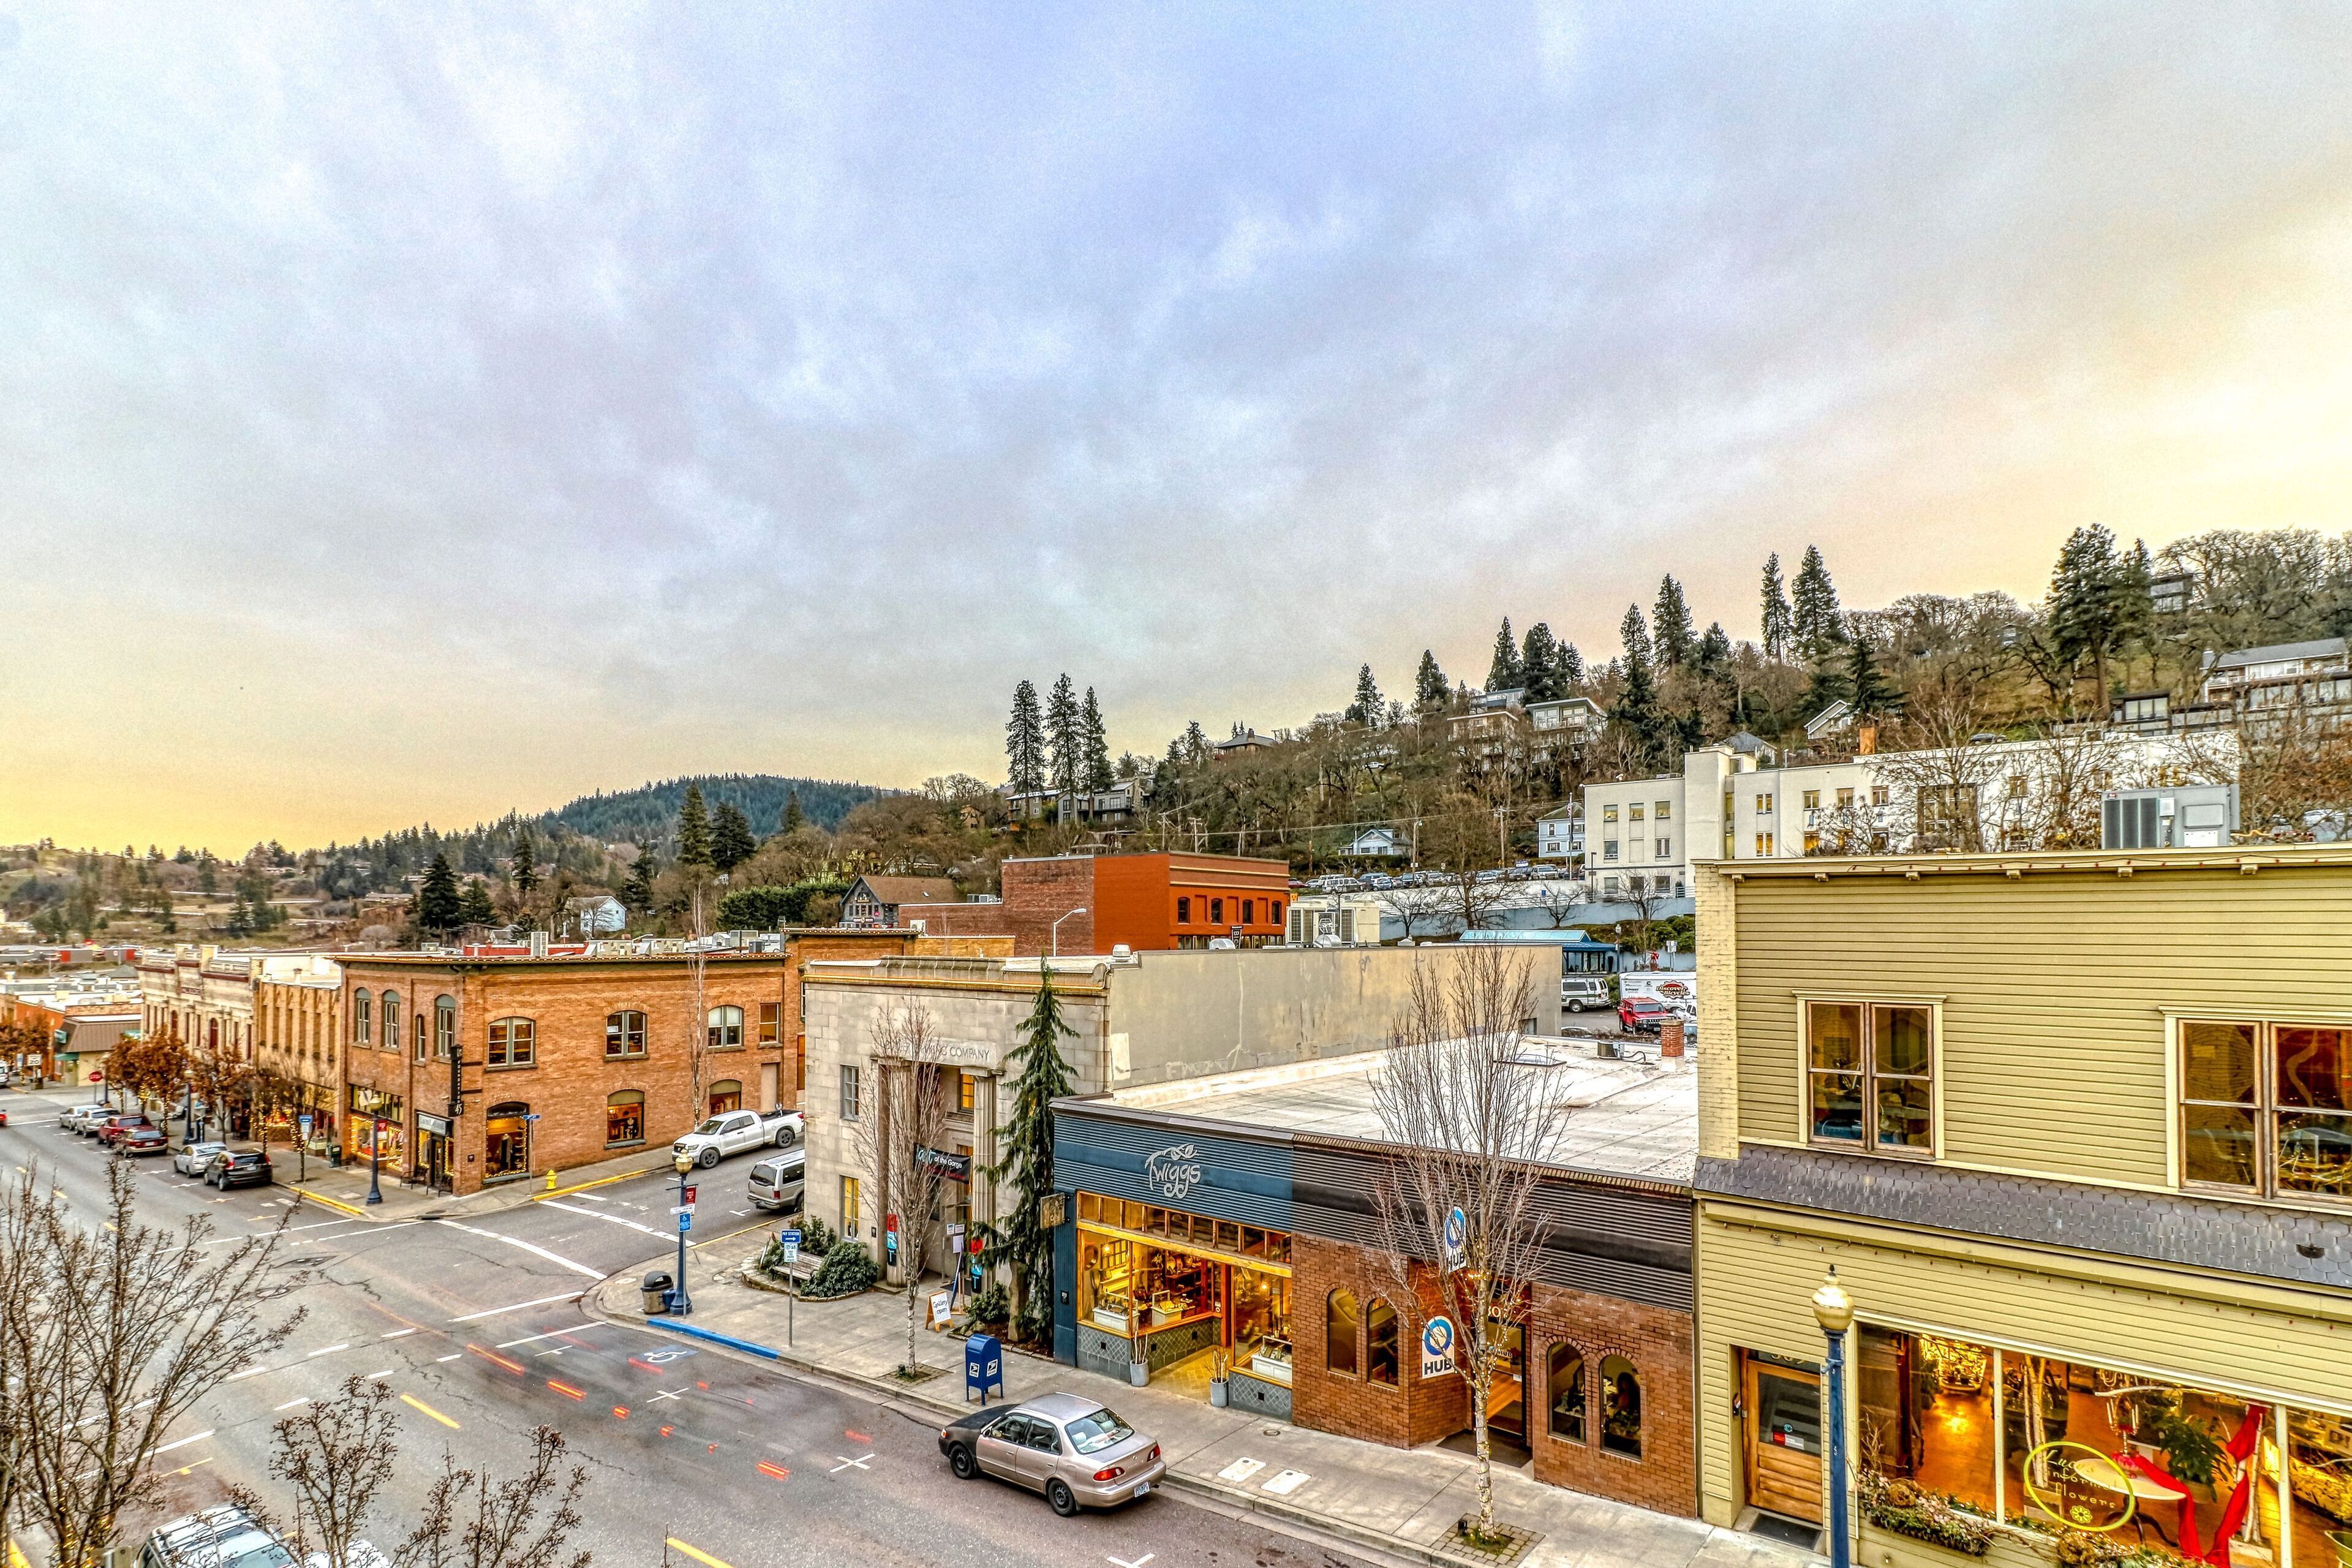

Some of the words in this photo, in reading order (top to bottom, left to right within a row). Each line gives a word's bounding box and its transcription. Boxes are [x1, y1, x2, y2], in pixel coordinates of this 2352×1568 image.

[949, 1046, 990, 1060] COMPANY
[454, 1103, 462, 1115] 45
[948, 1159, 962, 1169] Gorge
[1145, 1147, 1201, 1199] Twiggs
[1424, 1358, 1452, 1376] HUB
[2056, 1482, 2116, 1509] flowers
